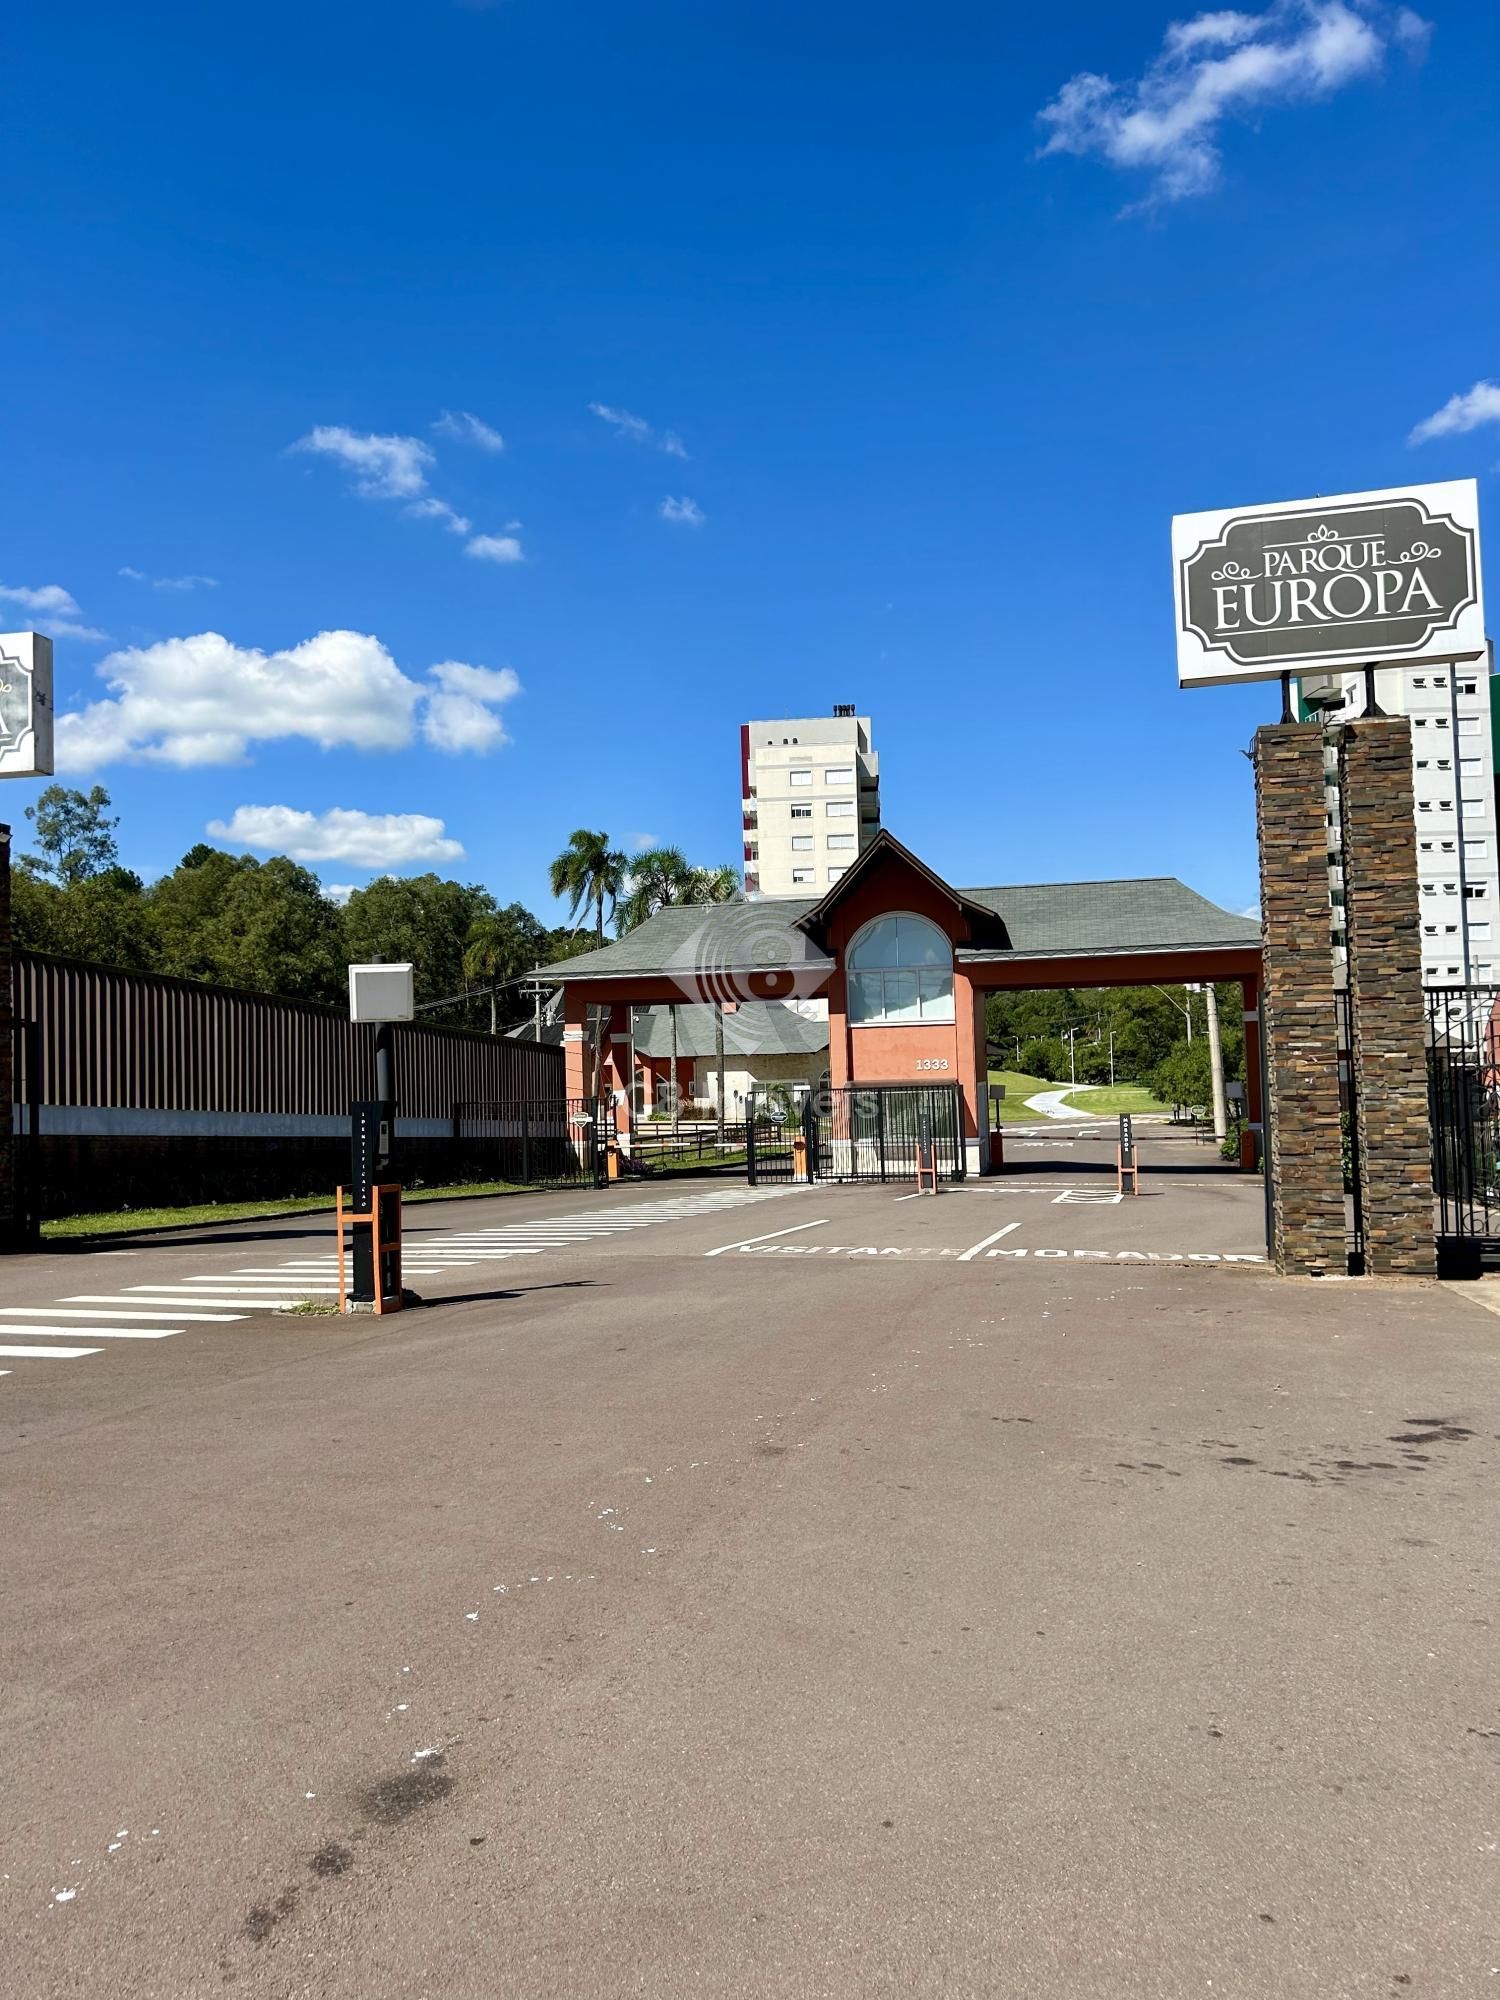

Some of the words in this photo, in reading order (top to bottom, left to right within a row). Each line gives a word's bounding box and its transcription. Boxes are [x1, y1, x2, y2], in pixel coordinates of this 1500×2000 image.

[1263, 540, 1387, 578] PARQUE
[1212, 567, 1444, 630] EUROPA
[916, 1059, 949, 1070] 1333
[739, 1245, 965, 1256] VISITANTE
[985, 1249, 1266, 1263] MORADOR
